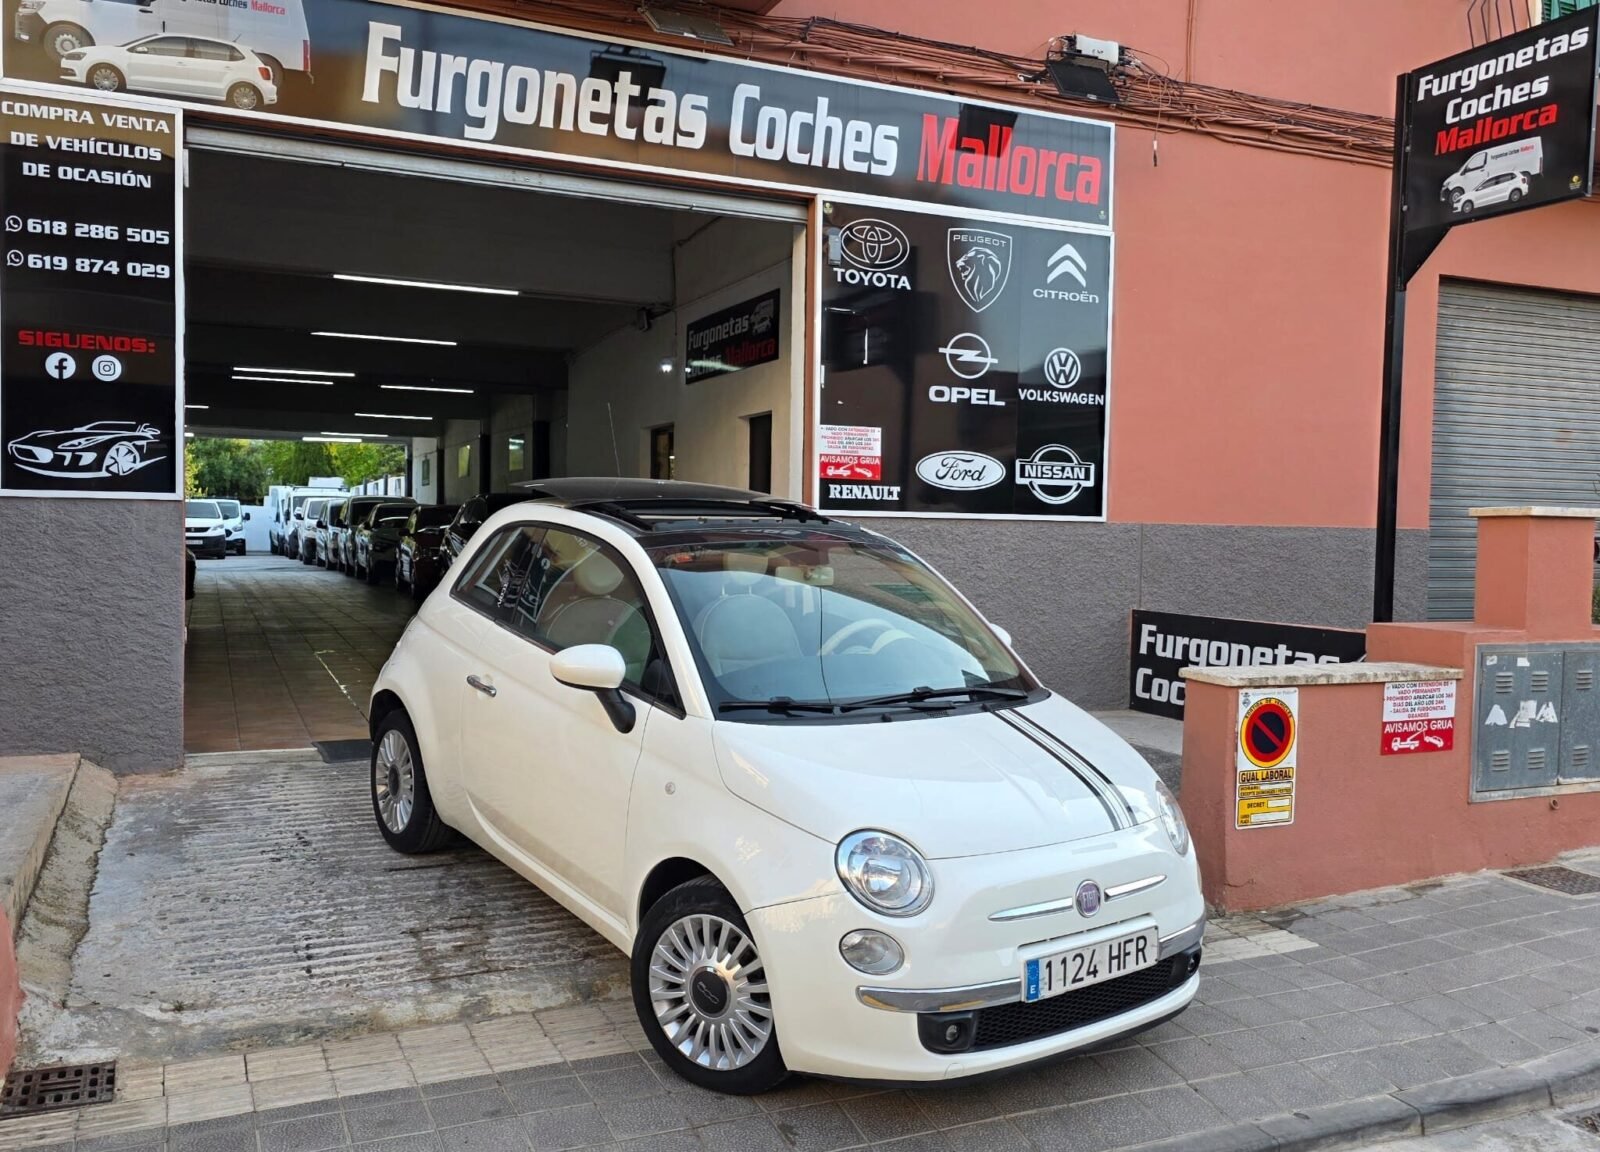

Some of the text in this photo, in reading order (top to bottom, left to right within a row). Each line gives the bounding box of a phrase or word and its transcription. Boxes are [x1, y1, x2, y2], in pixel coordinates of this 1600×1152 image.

[251, 0, 285, 15] Mallorca
[1417, 26, 1589, 102] Furgonetas
[1446, 75, 1549, 124] Coches
[1, 101, 170, 134] COMPRA VENTA
[362, 21, 1102, 205] Furgonetas Coches Mallorca
[1434, 103, 1558, 156] Mallorca
[10, 131, 162, 161] DE VEHÍCULOS
[22, 162, 151, 188] DE OCASIÓN
[27, 218, 170, 245] 618 286 505
[953, 234, 1007, 248] PEUGEOT
[27, 254, 170, 279] 619 874 029
[833, 267, 911, 290] TOYOTA
[18, 330, 156, 353] SIGUENOS:
[687, 314, 749, 350] Furgonetas
[928, 385, 1006, 406] OPEL
[1018, 388, 1105, 405] VOLKSWAGEN
[821, 455, 858, 464] AVISAMOS
[935, 456, 986, 482] Ford
[1024, 464, 1085, 480] NISSAN
[828, 484, 900, 500] RENAULT
[1384, 720, 1453, 733] AVISAMOS GRUA
[1241, 770, 1291, 782] GUAL LABORAL
[1045, 935, 1148, 992] 1124 HFR
[1030, 985, 1036, 994] E
